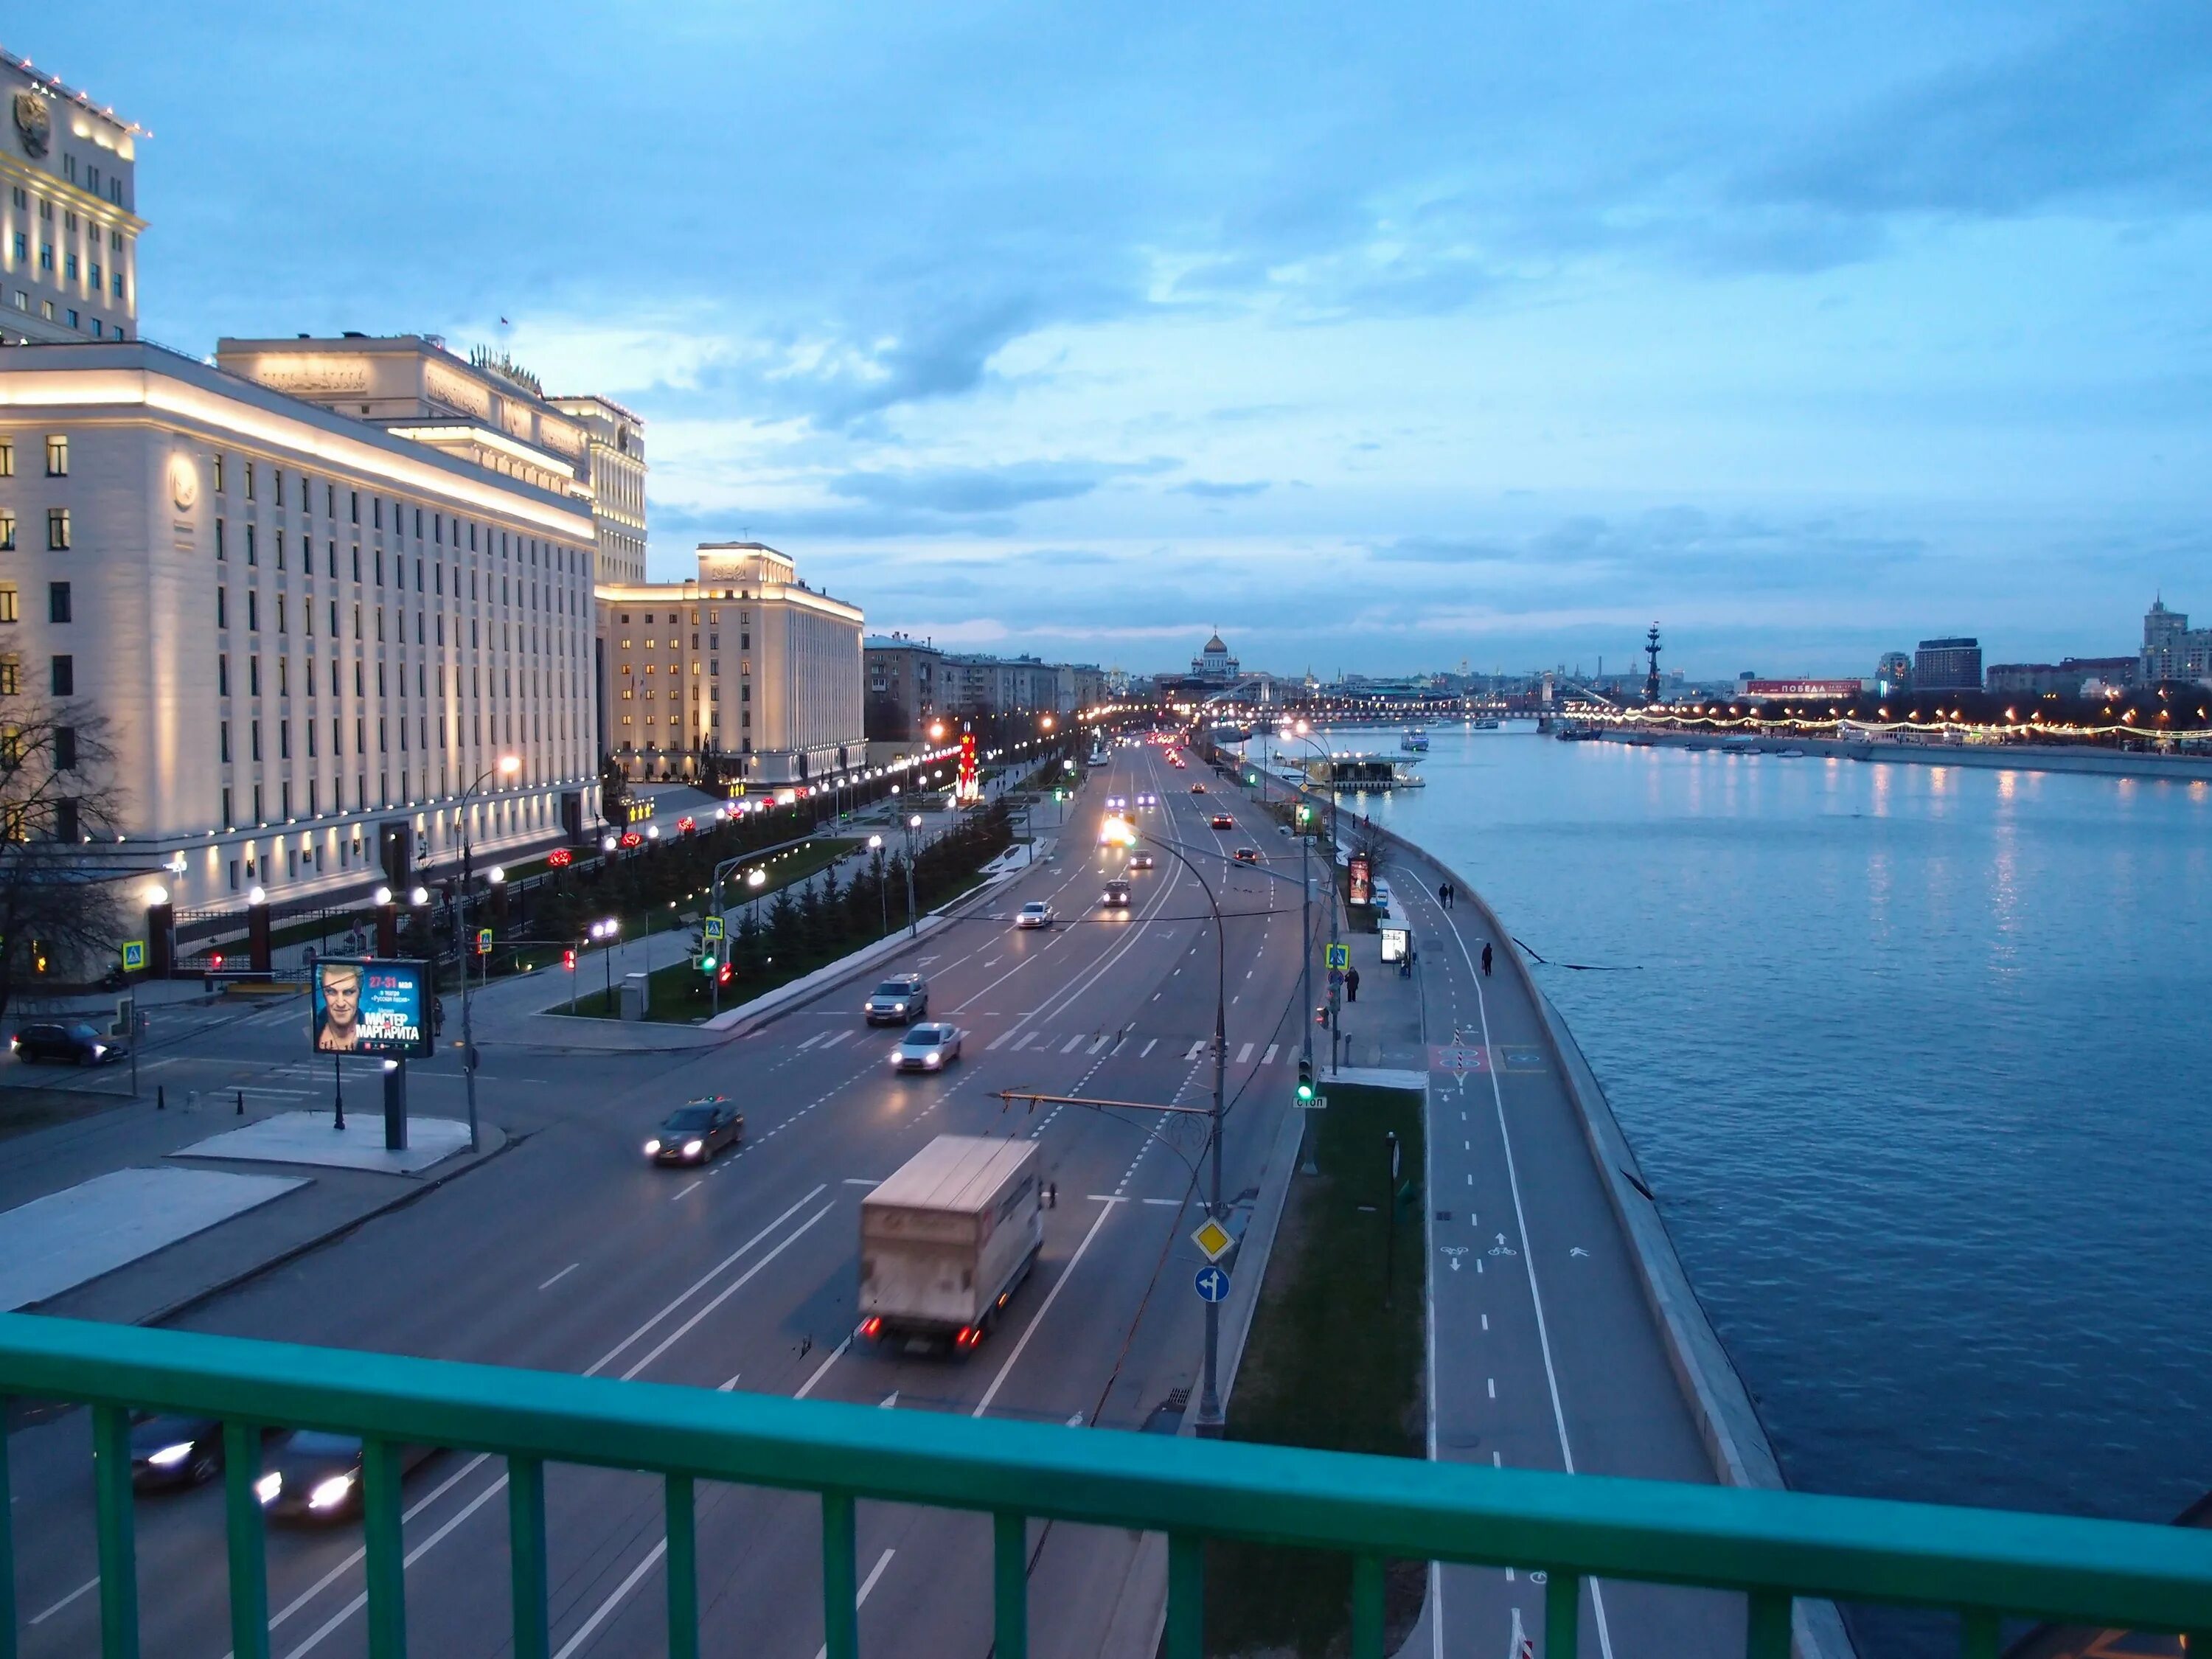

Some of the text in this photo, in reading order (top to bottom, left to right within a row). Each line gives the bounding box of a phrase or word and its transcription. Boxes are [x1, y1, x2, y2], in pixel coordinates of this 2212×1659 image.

[369, 976, 397, 988] 27-31
[365, 1012, 408, 1026] МАСТЕР
[355, 1024, 420, 1040] МАРГАРИТА
